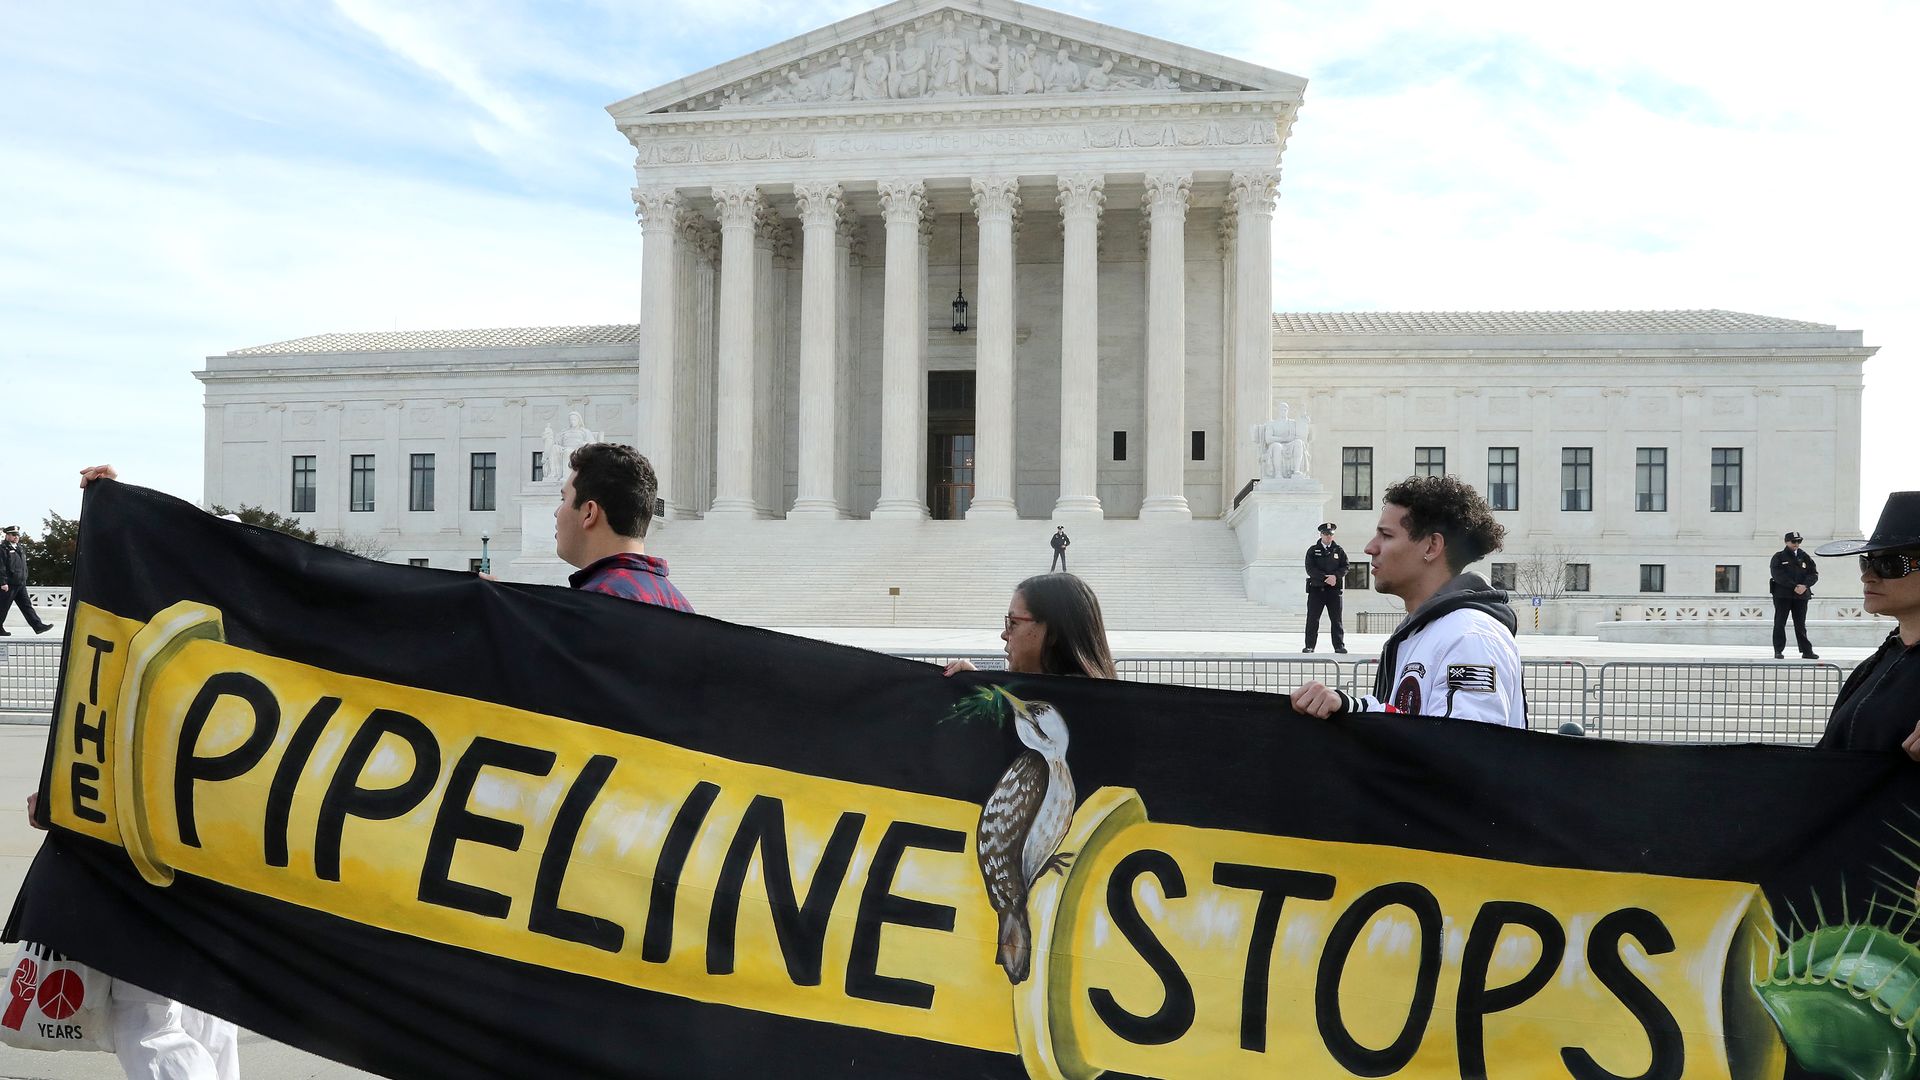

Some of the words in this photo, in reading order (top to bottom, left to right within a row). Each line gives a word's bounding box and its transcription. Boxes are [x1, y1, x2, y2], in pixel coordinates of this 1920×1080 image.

[894, 134, 960, 151] JUSTICE
[968, 131, 1027, 148] UNDER
[1035, 130, 1070, 146] LAW
[71, 634, 114, 824] THE
[174, 672, 967, 1010] PIPELINE
[1088, 848, 1685, 1080] STOPS
[37, 1022, 83, 1040] YEARS
